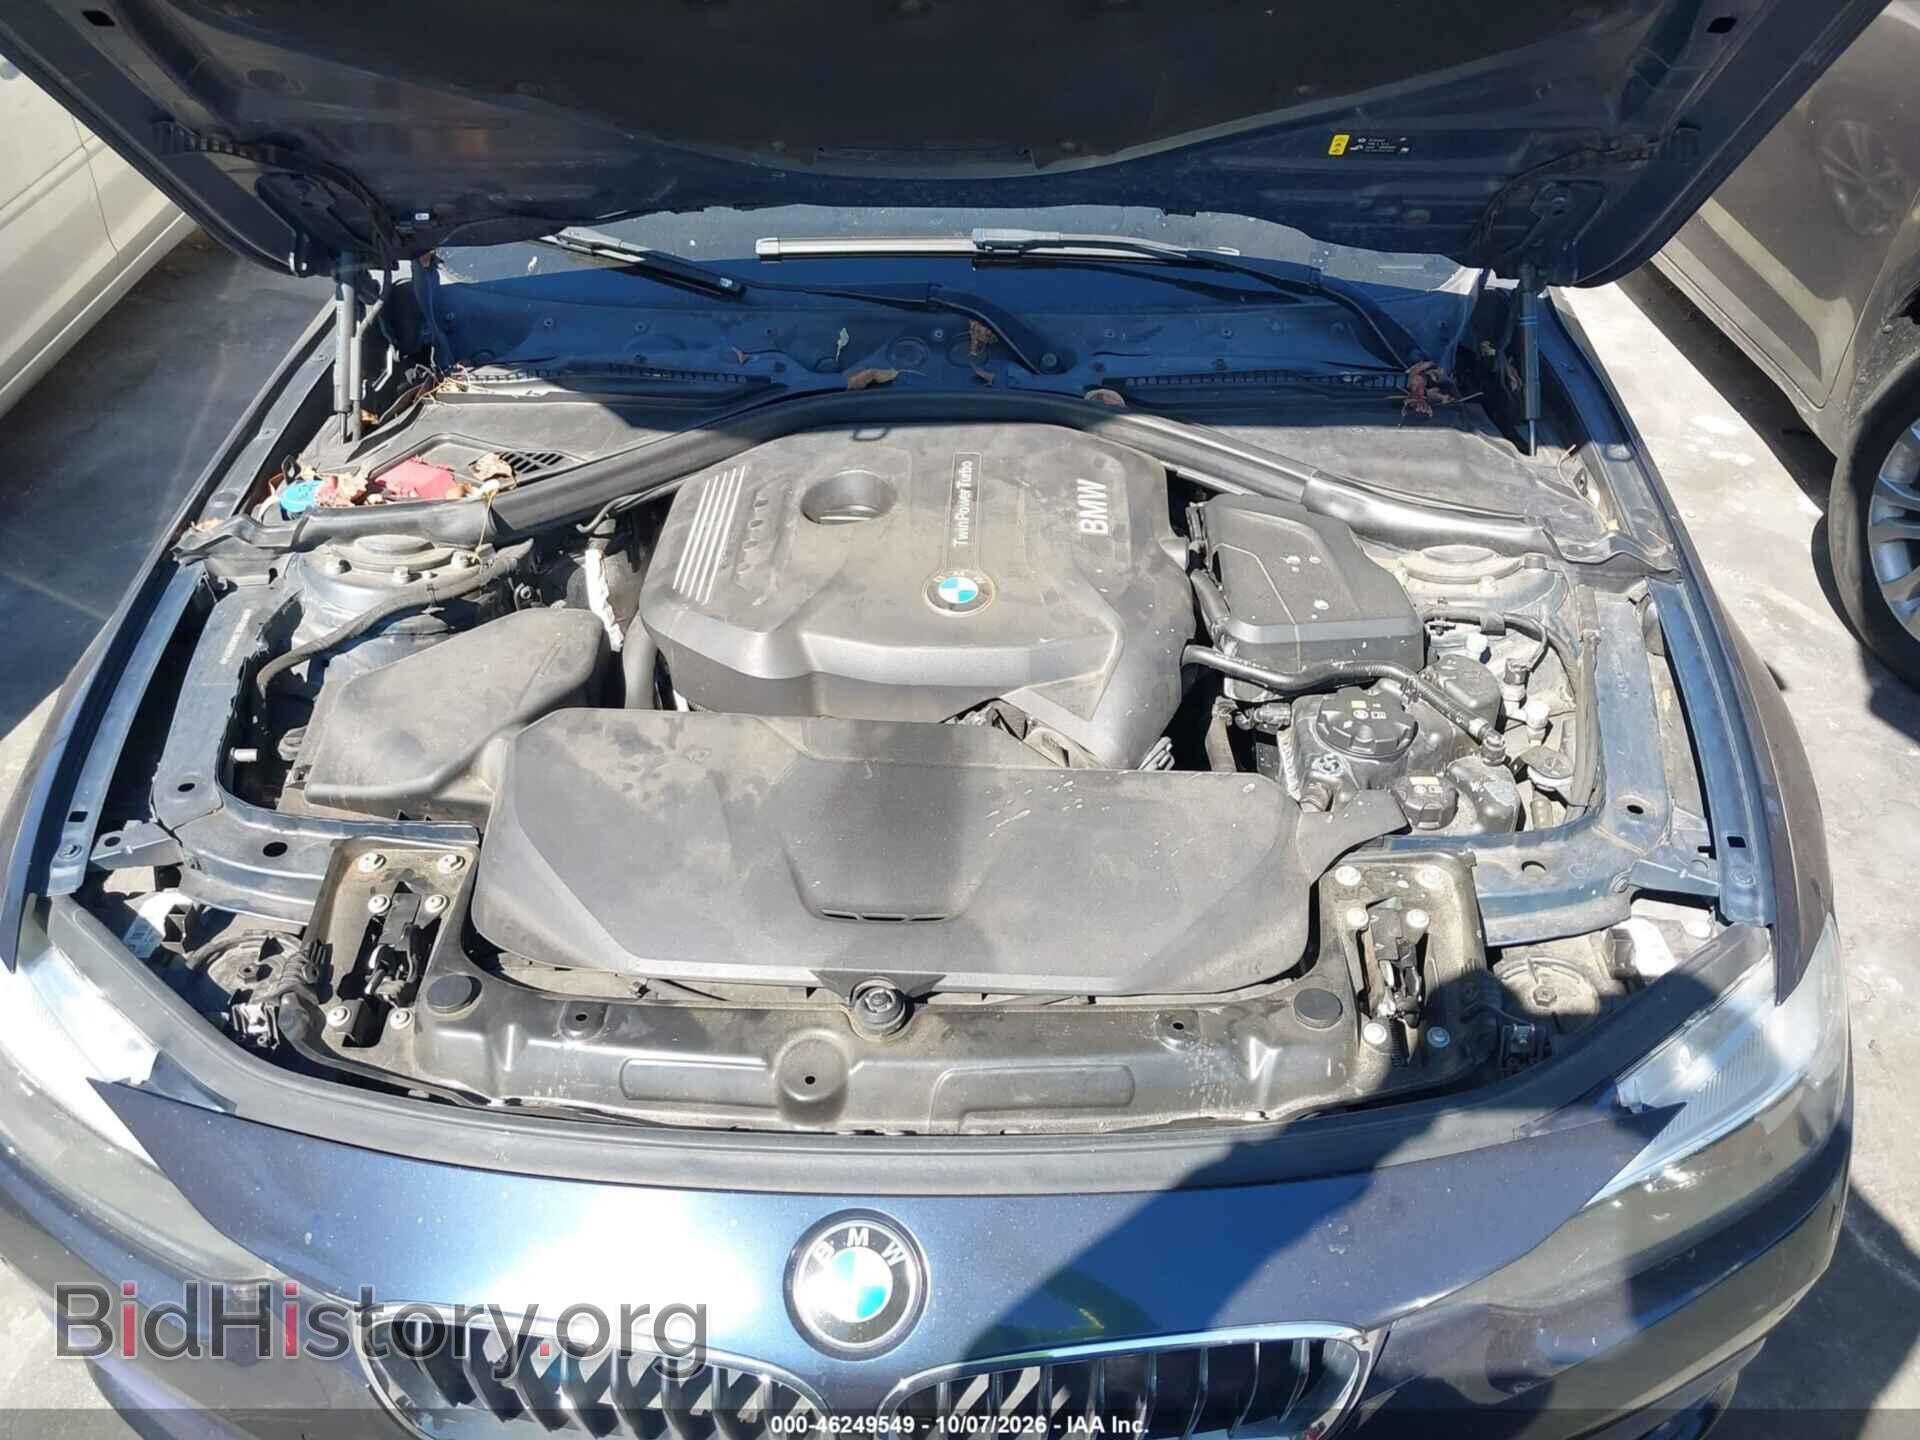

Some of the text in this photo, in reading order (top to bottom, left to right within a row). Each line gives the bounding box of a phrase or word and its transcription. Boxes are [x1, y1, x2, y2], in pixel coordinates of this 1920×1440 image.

[952, 460, 972, 547] TwinPower Turbo
[1077, 478, 1108, 535] BMW
[812, 1227, 905, 1267] BMW
